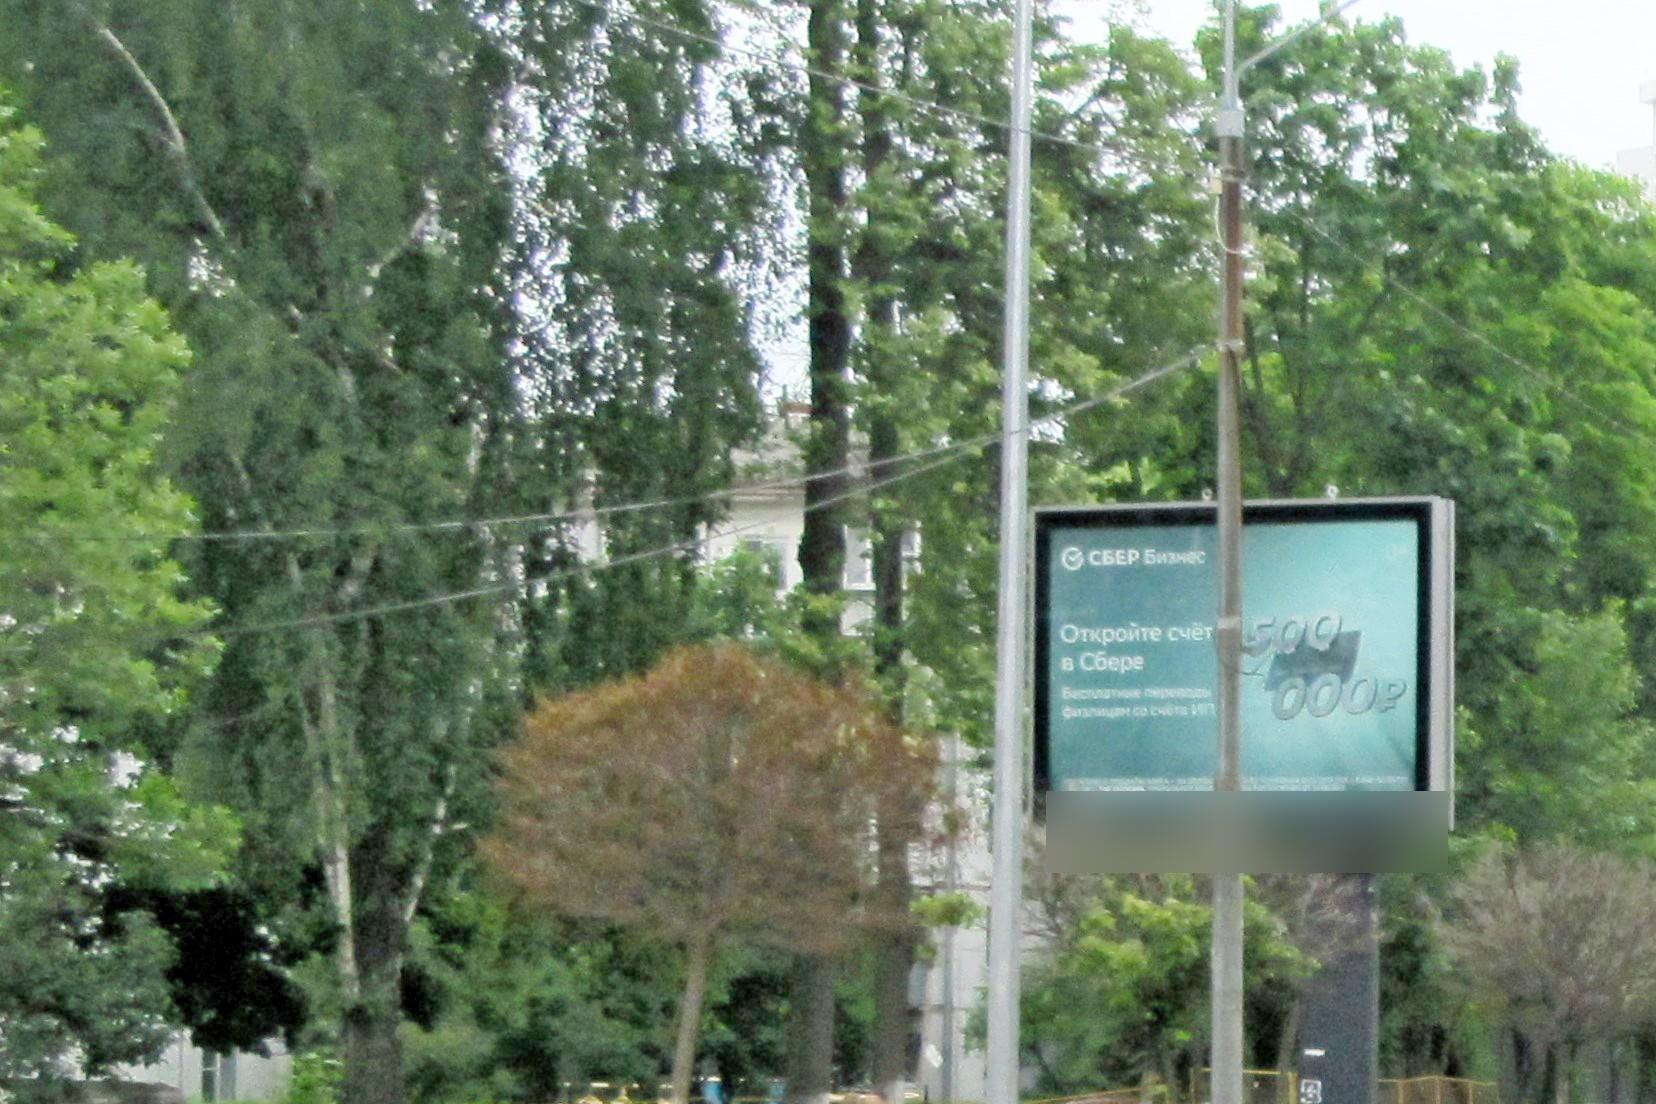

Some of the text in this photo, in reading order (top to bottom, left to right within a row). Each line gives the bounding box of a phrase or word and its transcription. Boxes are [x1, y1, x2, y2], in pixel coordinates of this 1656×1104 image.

[1088, 548, 1206, 565] СБЕР Бизнес
[1060, 622, 1214, 646] Откройте счёт
[1061, 651, 1145, 674] в Сбере
